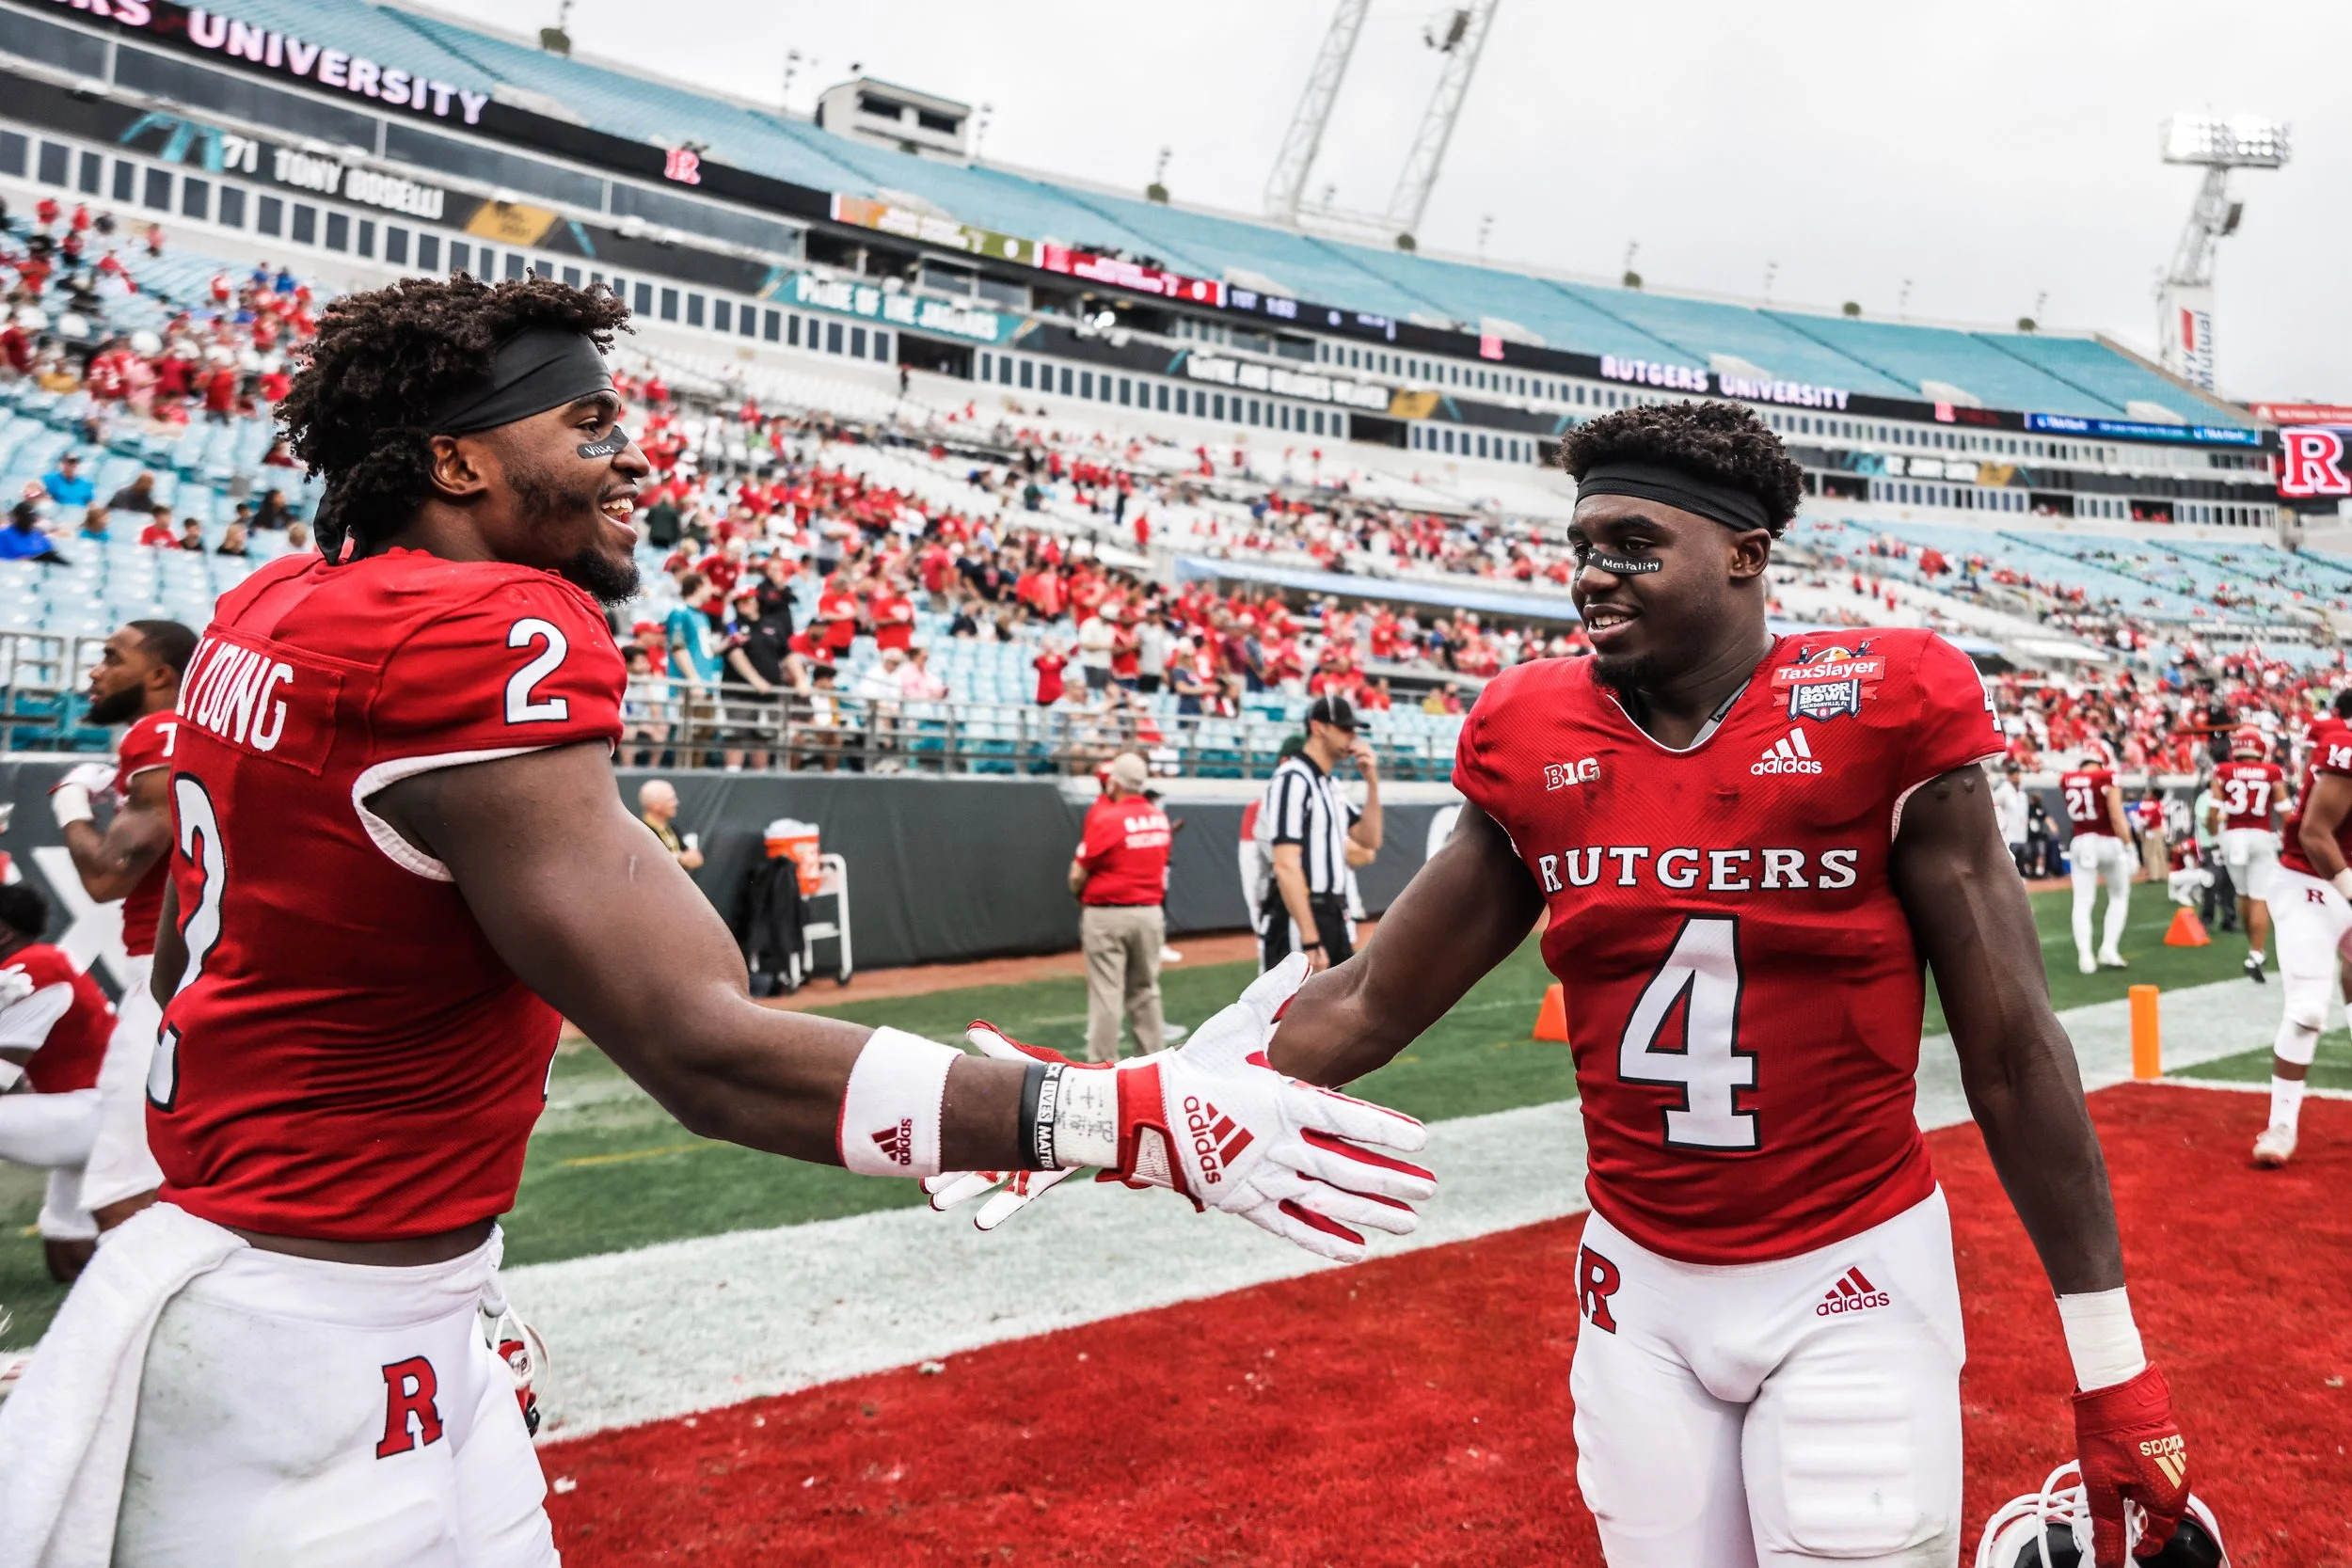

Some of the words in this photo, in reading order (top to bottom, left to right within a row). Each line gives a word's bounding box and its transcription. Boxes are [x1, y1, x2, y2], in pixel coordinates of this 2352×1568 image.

[188, 8, 489, 124] UNIVERSITY
[223, 135, 259, 173] 71
[2193, 309, 2214, 391] Mutual
[1601, 355, 1708, 393] RUTGERS
[1719, 374, 1851, 411] UNIVERSITY
[2280, 427, 2351, 495] R
[1602, 559, 1659, 571] Mentality
[504, 617, 568, 726] 2
[1778, 661, 1879, 680] TaxSlayer
[1800, 682, 1851, 696] GATOR
[1800, 691, 1851, 705] BOWL
[1750, 756, 1822, 776] adidas
[2065, 788, 2098, 821] 21
[2224, 779, 2271, 816] 37
[1538, 845, 1858, 894] RUTGERS
[2308, 889, 2326, 905] R
[1617, 914, 1761, 1151] 4
[1041, 1083, 1055, 1119] LIVES
[899, 1118, 913, 1165] adidas
[1184, 1096, 1221, 1184] adidas
[1580, 1243, 1620, 1334] R
[1816, 1290, 1890, 1317] adidas
[376, 1355, 443, 1460] R
